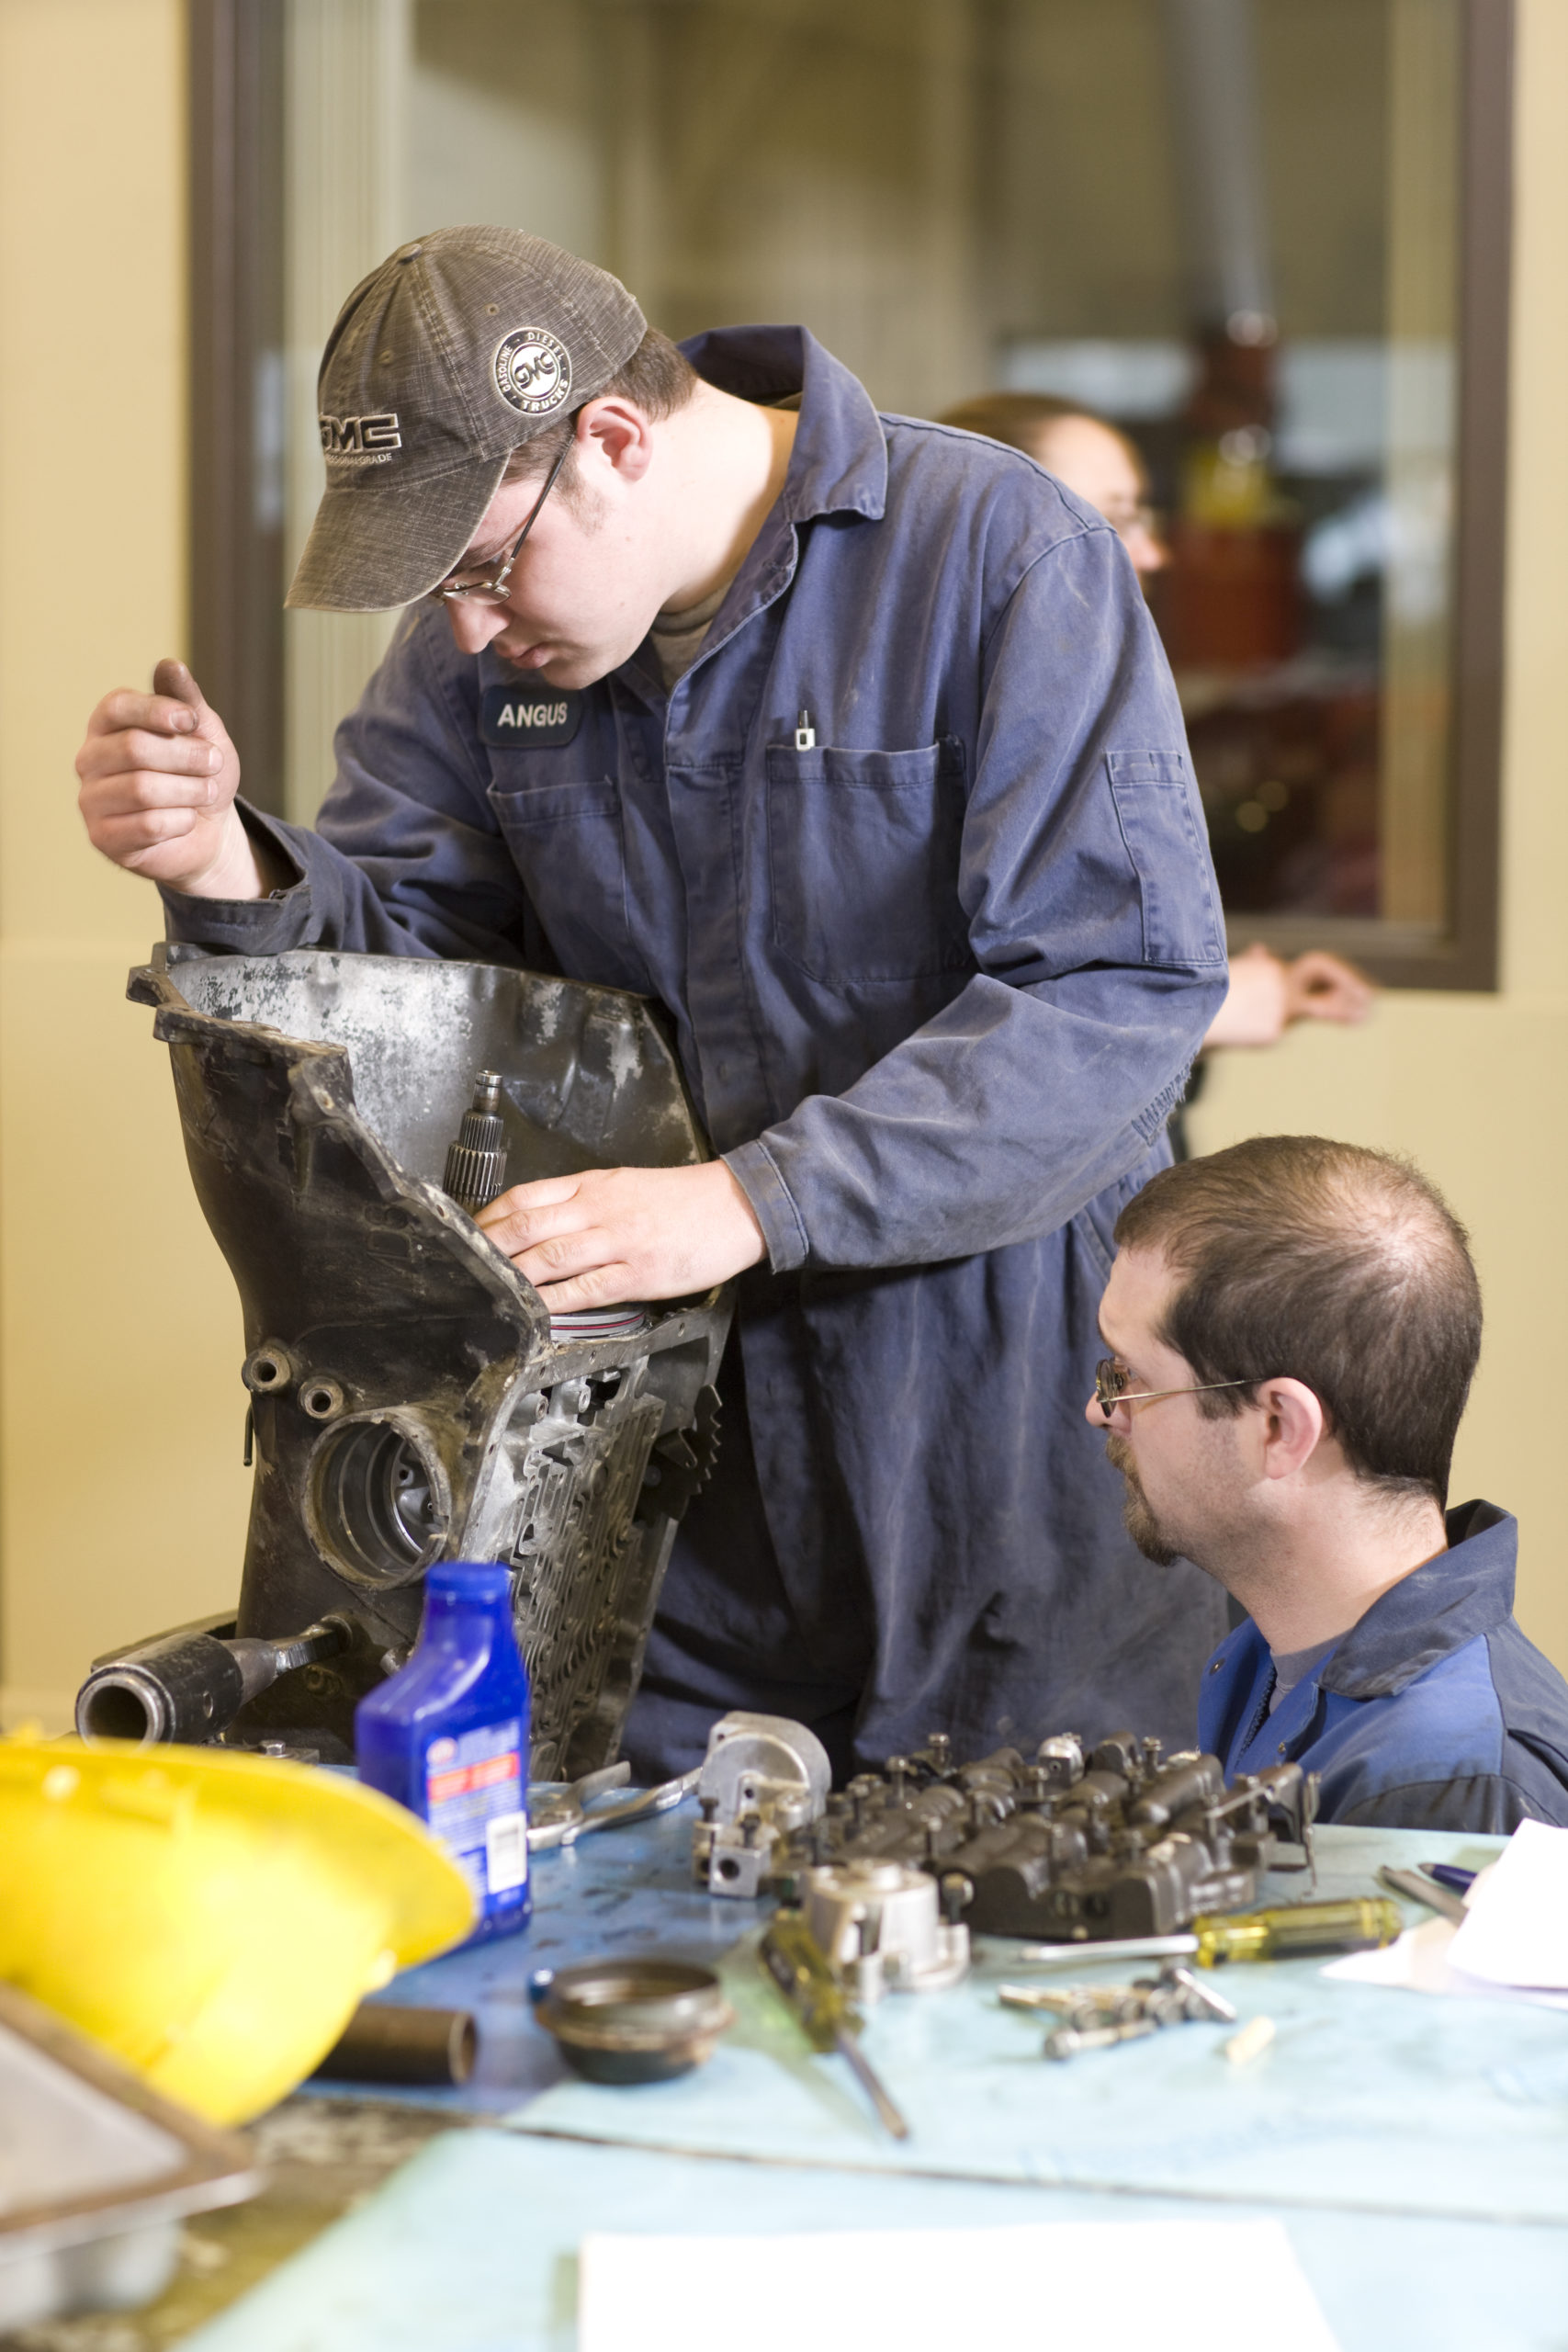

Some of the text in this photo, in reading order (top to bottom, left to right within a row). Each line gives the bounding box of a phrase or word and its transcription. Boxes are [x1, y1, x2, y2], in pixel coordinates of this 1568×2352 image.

[499, 332, 568, 412] GASOLINE DIESEL TRUCKS
[514, 351, 555, 390] GMC
[497, 701, 568, 728] ANGUS
